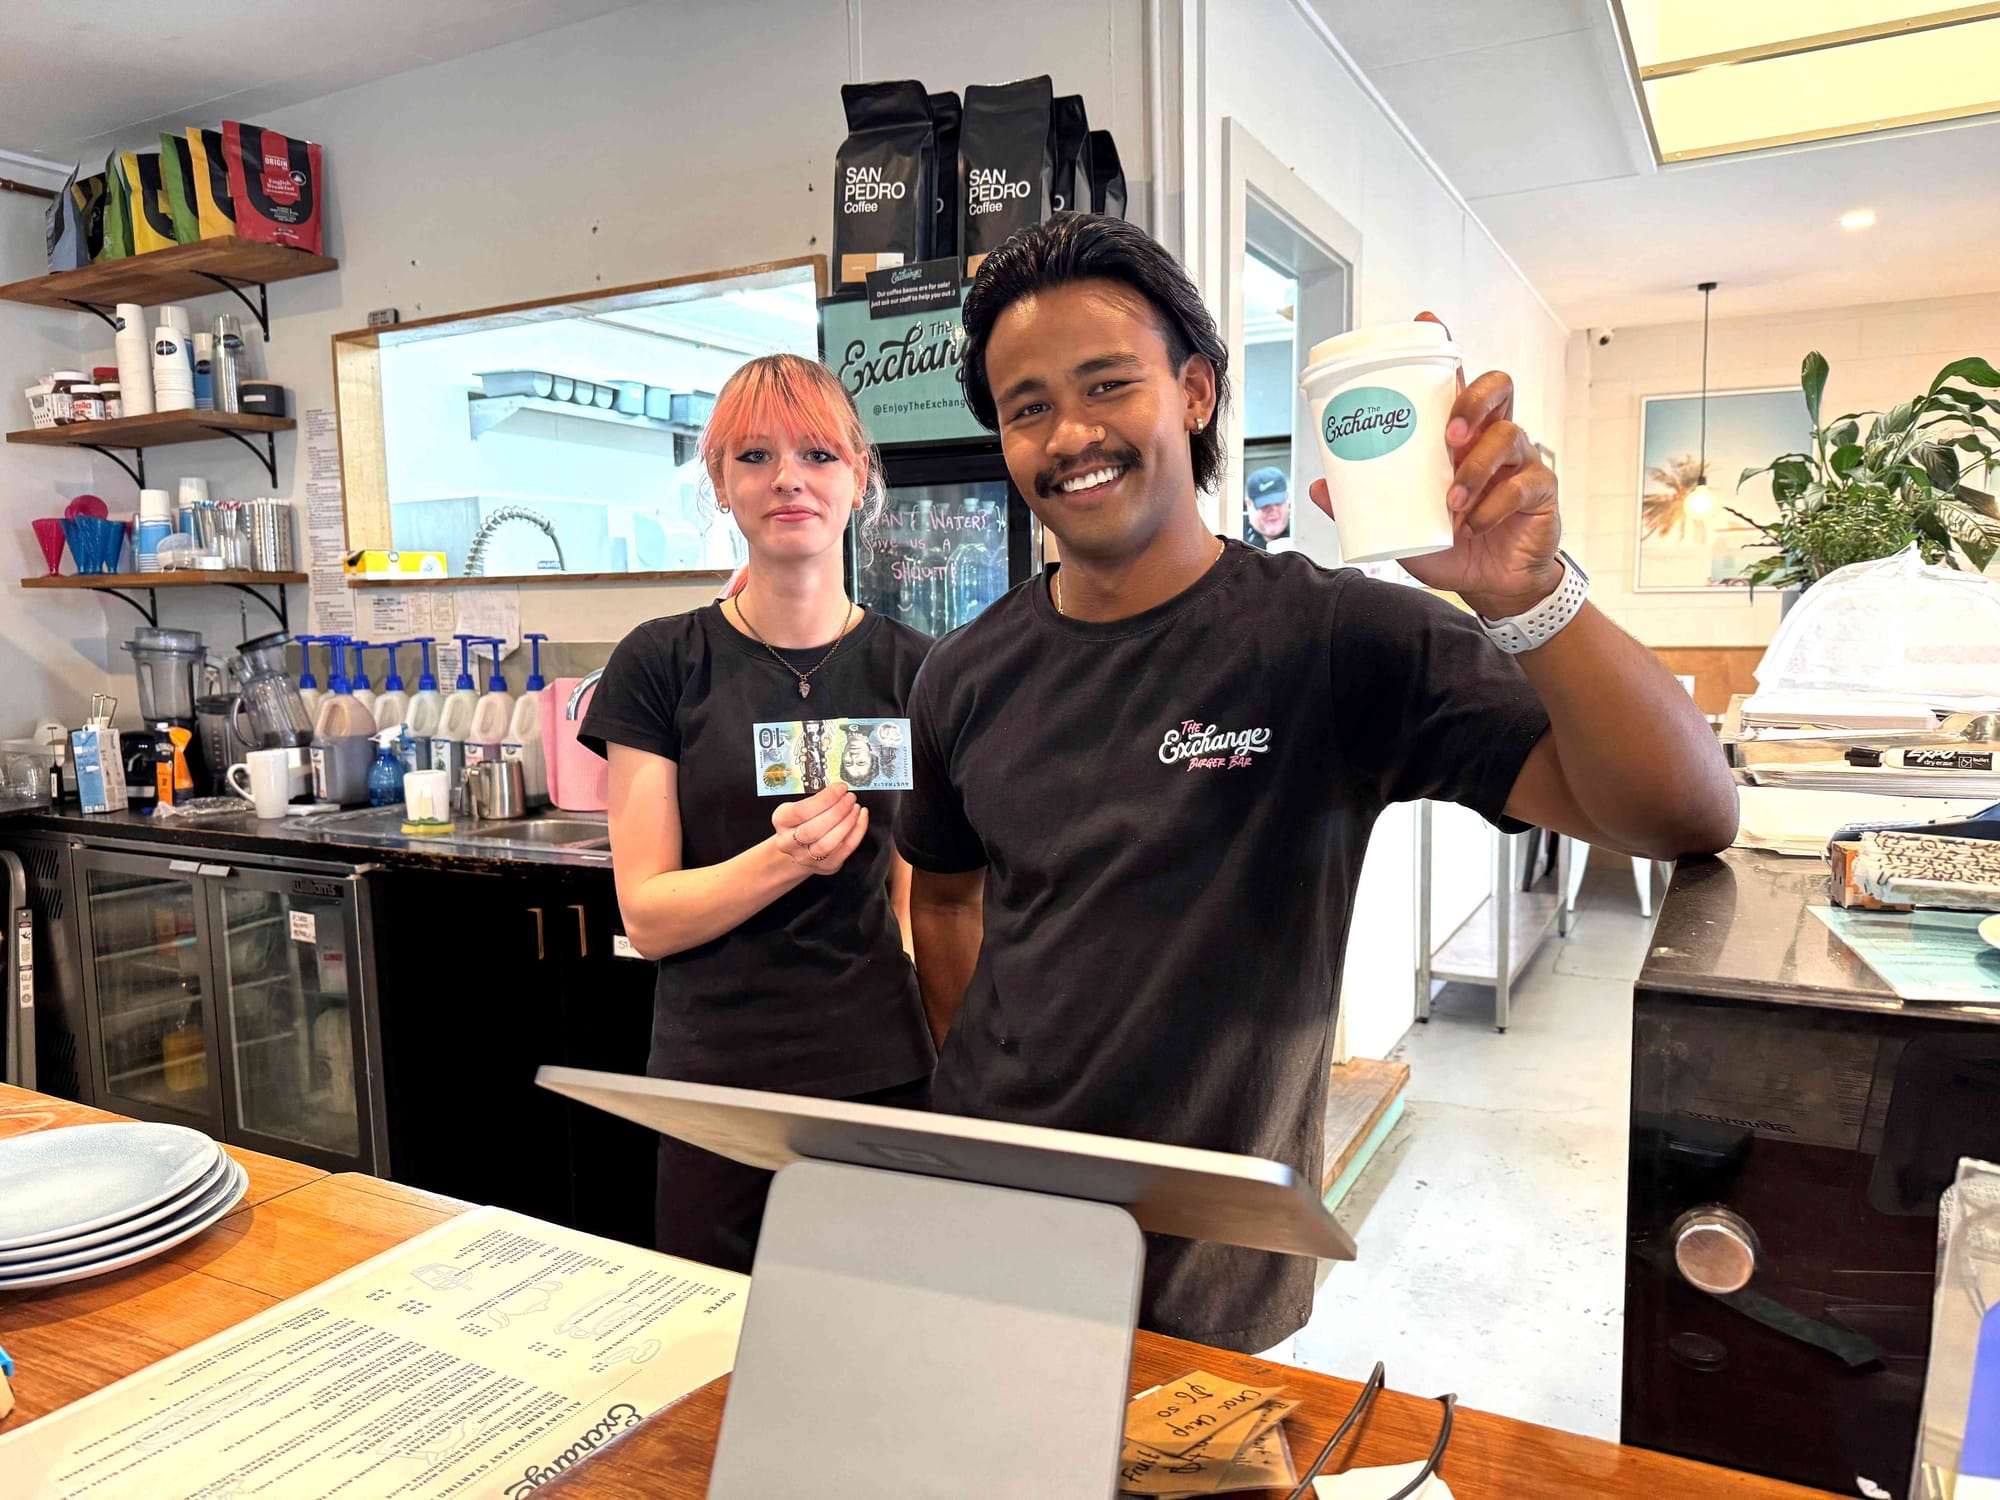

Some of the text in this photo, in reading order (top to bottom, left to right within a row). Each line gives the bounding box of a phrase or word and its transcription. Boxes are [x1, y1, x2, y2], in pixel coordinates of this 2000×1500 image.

[264, 156, 288, 167] ORIGIN
[846, 167, 882, 184] SAN
[969, 168, 1007, 186] SAN
[845, 182, 905, 201] PEDRO
[969, 181, 1030, 203] PEDRO
[844, 201, 878, 214] Coffee
[969, 201, 1003, 216] Coffee
[886, 288, 902, 297] coffee
[903, 286, 918, 295] beans
[918, 294, 930, 302] help
[930, 292, 940, 300] you
[929, 321, 953, 336] The
[838, 321, 967, 398] Exchan
[873, 398, 967, 415] @EnjoyTheExchang
[1367, 406, 1381, 414] The
[1326, 407, 1411, 443] Exchange
[929, 508, 989, 531] WATER?
[943, 538, 951, 552] A
[759, 727, 785, 749] 10
[1181, 720, 1203, 735] THE
[1158, 724, 1272, 764] Exchange
[1187, 754, 1252, 772] BURGER BAR
[1907, 750, 1955, 762] EXPO
[603, 1264, 625, 1275] TEA
[701, 1291, 739, 1314] COFFEE
[289, 1310, 332, 1330] ADD ONS
[326, 1325, 377, 1350] PANCAKES
[336, 1335, 402, 1368] SMASHED AVO
[308, 1344, 429, 1410] EGG AND BACON ON TOAST
[395, 1356, 463, 1394] FRENCH TOAST
[353, 1369, 496, 1455] THE EXCHANGE BREAKY BURGER
[402, 1380, 525, 1455] THE EXCHANGE BIG BREAKFAST
[514, 1395, 569, 1430] EGGS BENNY
[1164, 1389, 1262, 1437] Choc Chip
[434, 1400, 583, 1498] ALL DAY BREAKFAST STARTING
[1120, 1450, 1161, 1483] Fruit
